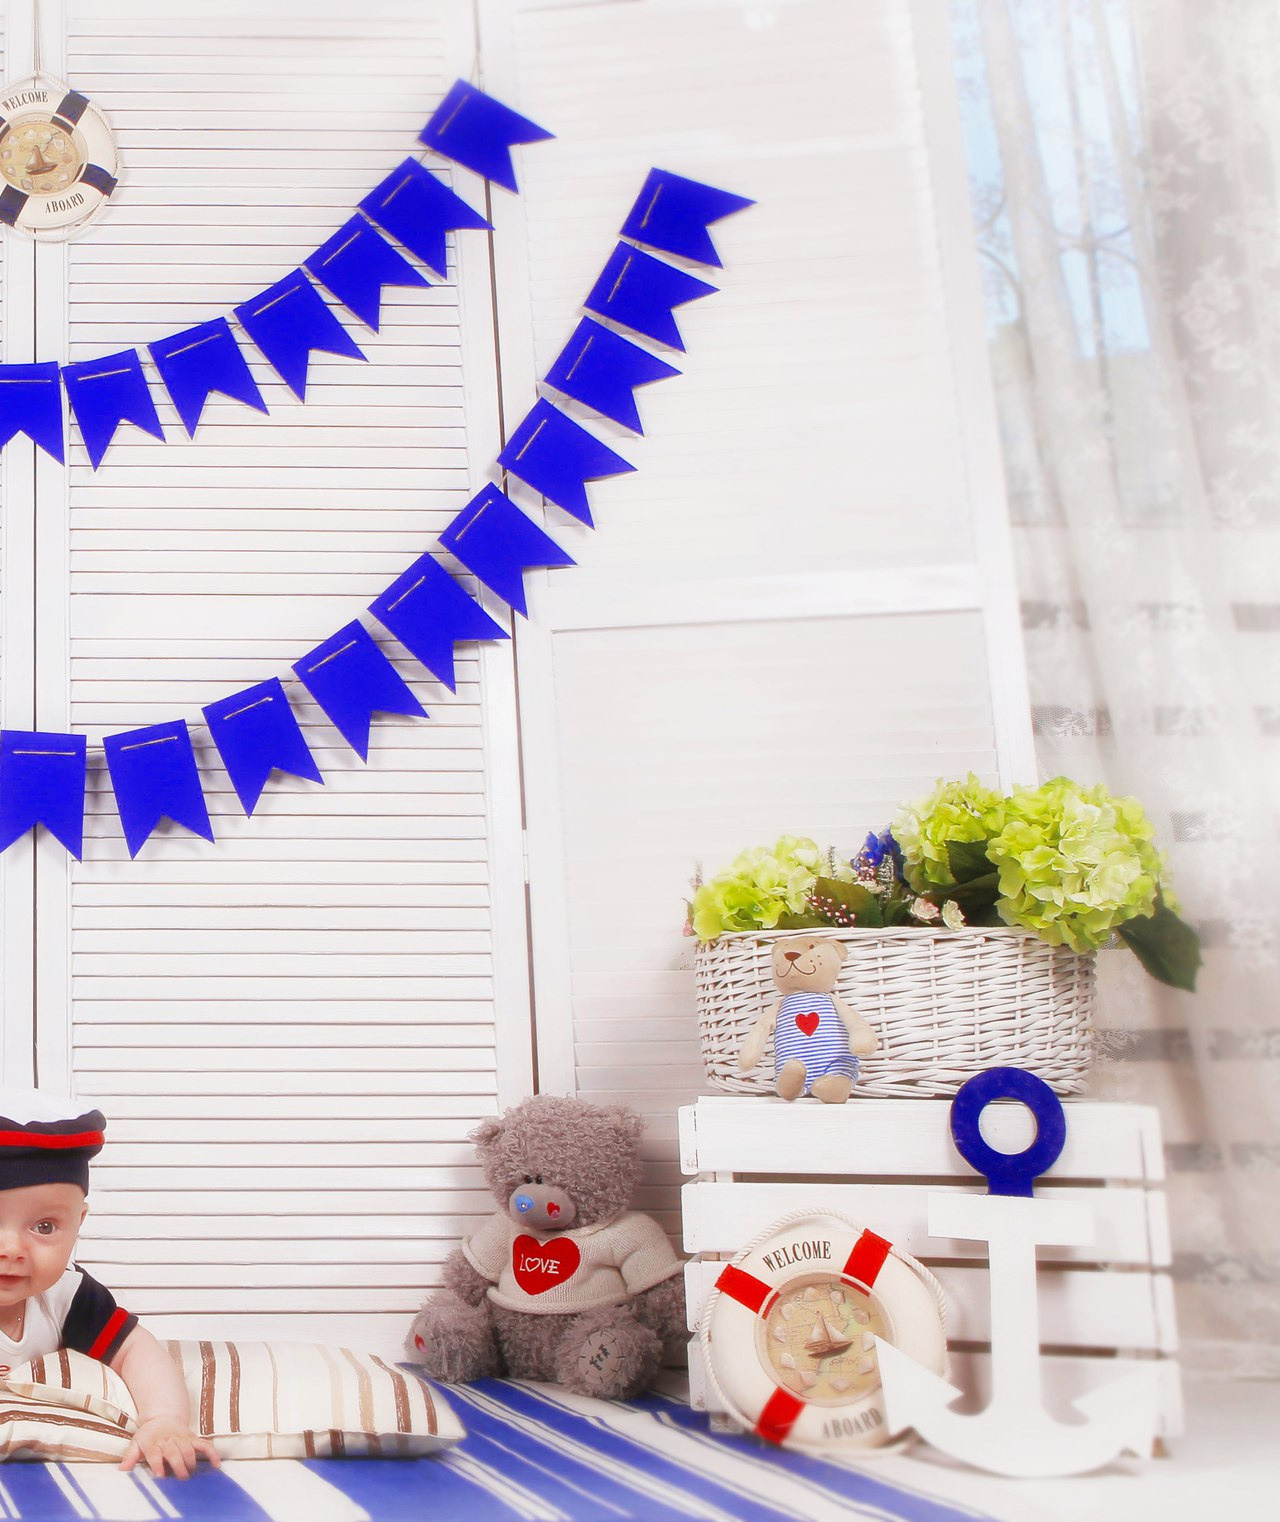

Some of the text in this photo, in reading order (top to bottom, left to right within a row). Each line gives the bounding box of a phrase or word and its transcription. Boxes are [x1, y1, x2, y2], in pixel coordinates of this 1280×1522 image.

[2, 91, 49, 112] WELCOME
[45, 192, 85, 214] ABOARD
[519, 1253, 560, 1275] LOVE
[762, 1240, 832, 1272] WELCOME
[822, 1407, 883, 1439] ABOARD
